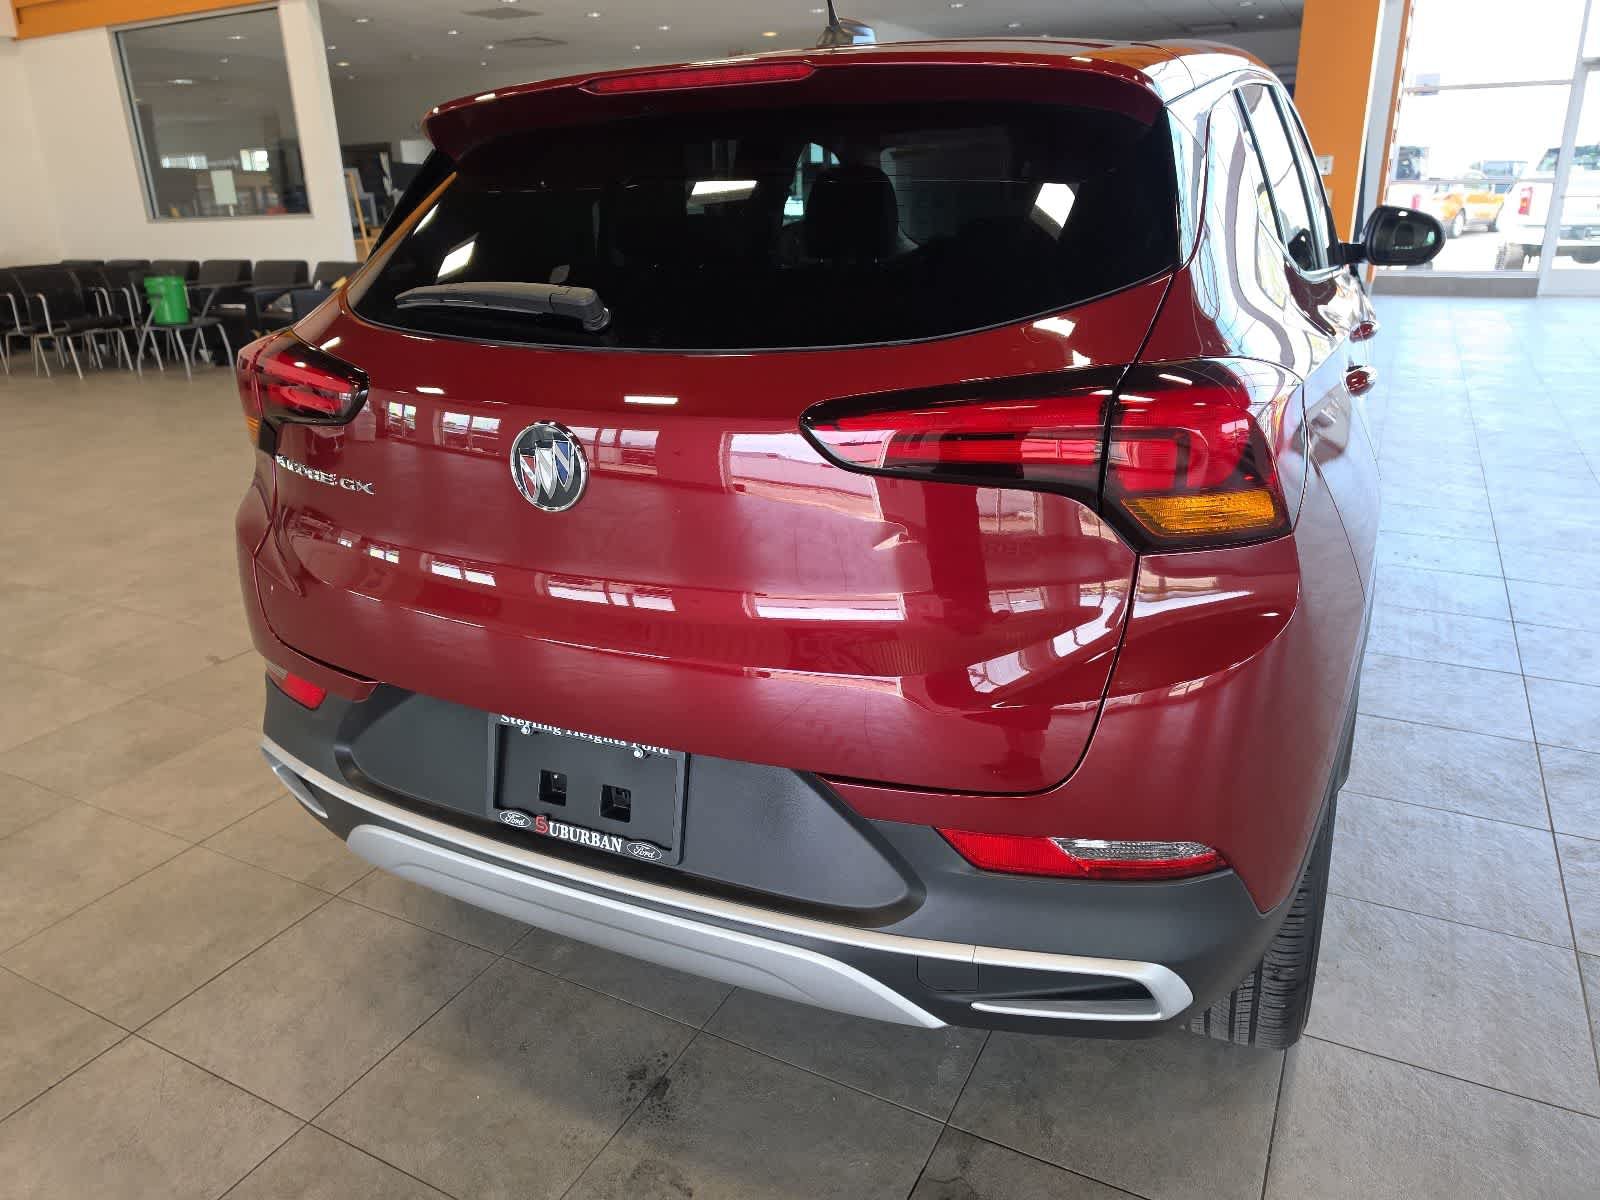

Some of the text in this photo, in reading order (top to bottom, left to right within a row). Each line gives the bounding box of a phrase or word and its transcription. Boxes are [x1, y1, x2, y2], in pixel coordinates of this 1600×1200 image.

[339, 477, 376, 495] GX
[504, 811, 656, 860] Ford SUBURBAN Ford
